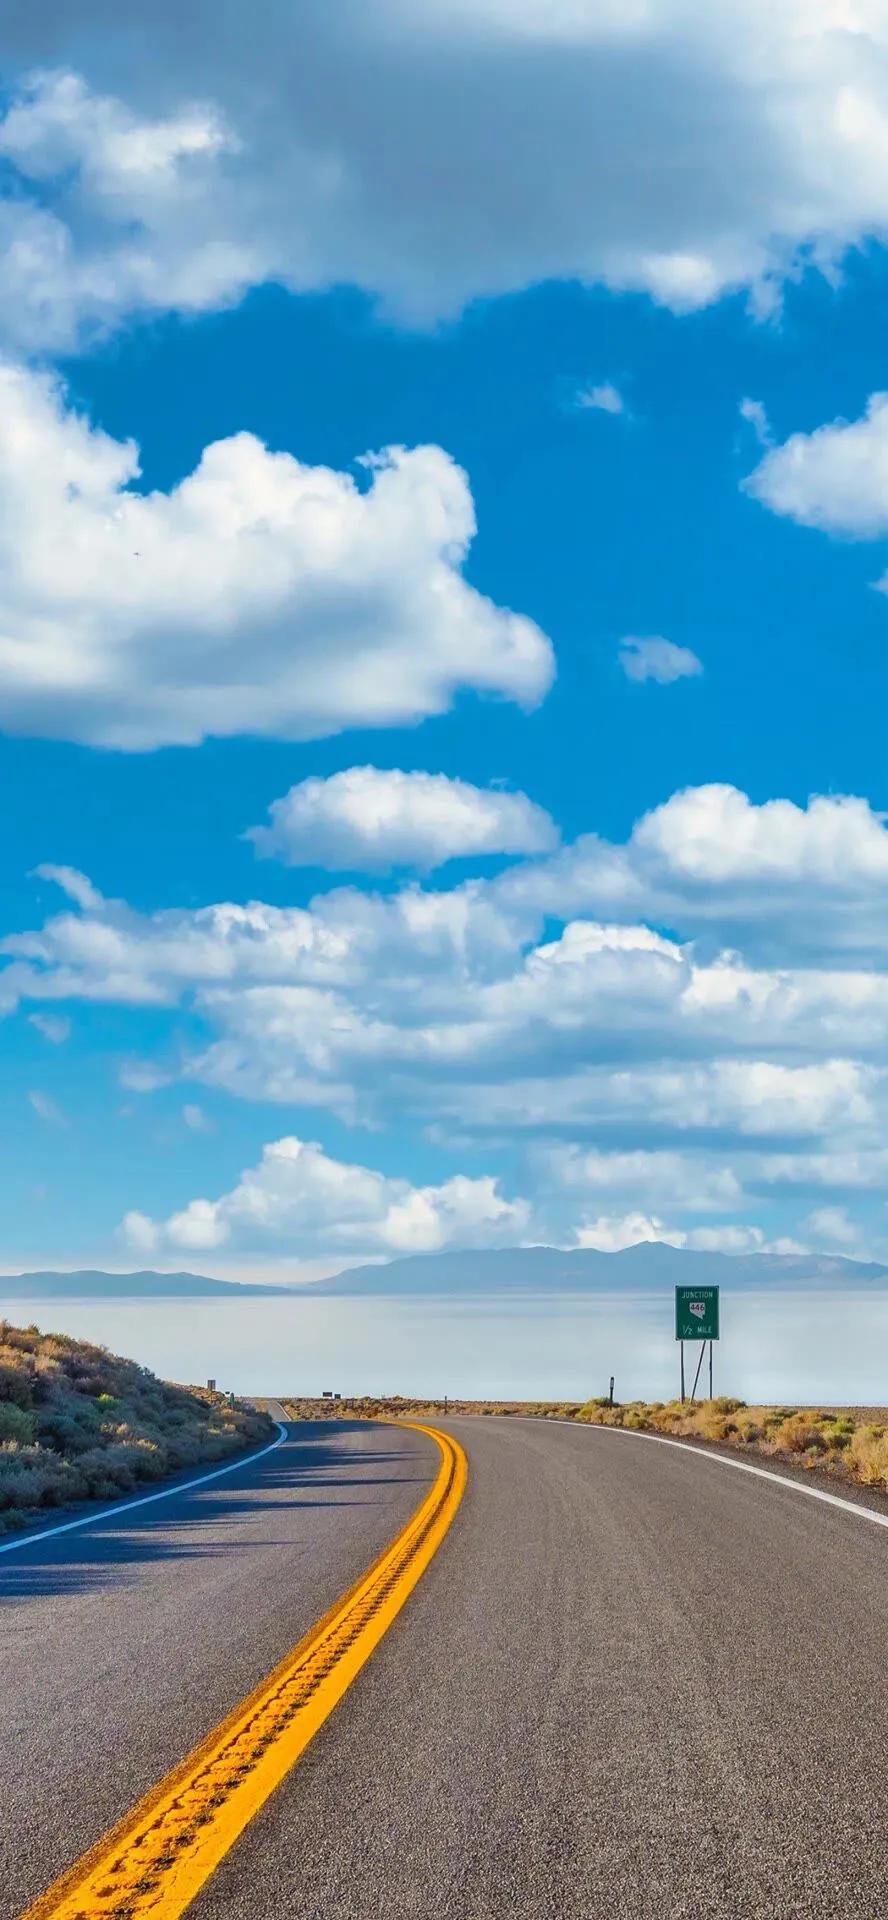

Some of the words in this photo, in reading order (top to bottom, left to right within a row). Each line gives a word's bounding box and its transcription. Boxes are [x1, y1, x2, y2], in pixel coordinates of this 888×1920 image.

[681, 1291, 713, 1299] JUNCTION
[690, 1303, 705, 1311] 446
[697, 1326, 712, 1334] MILE
